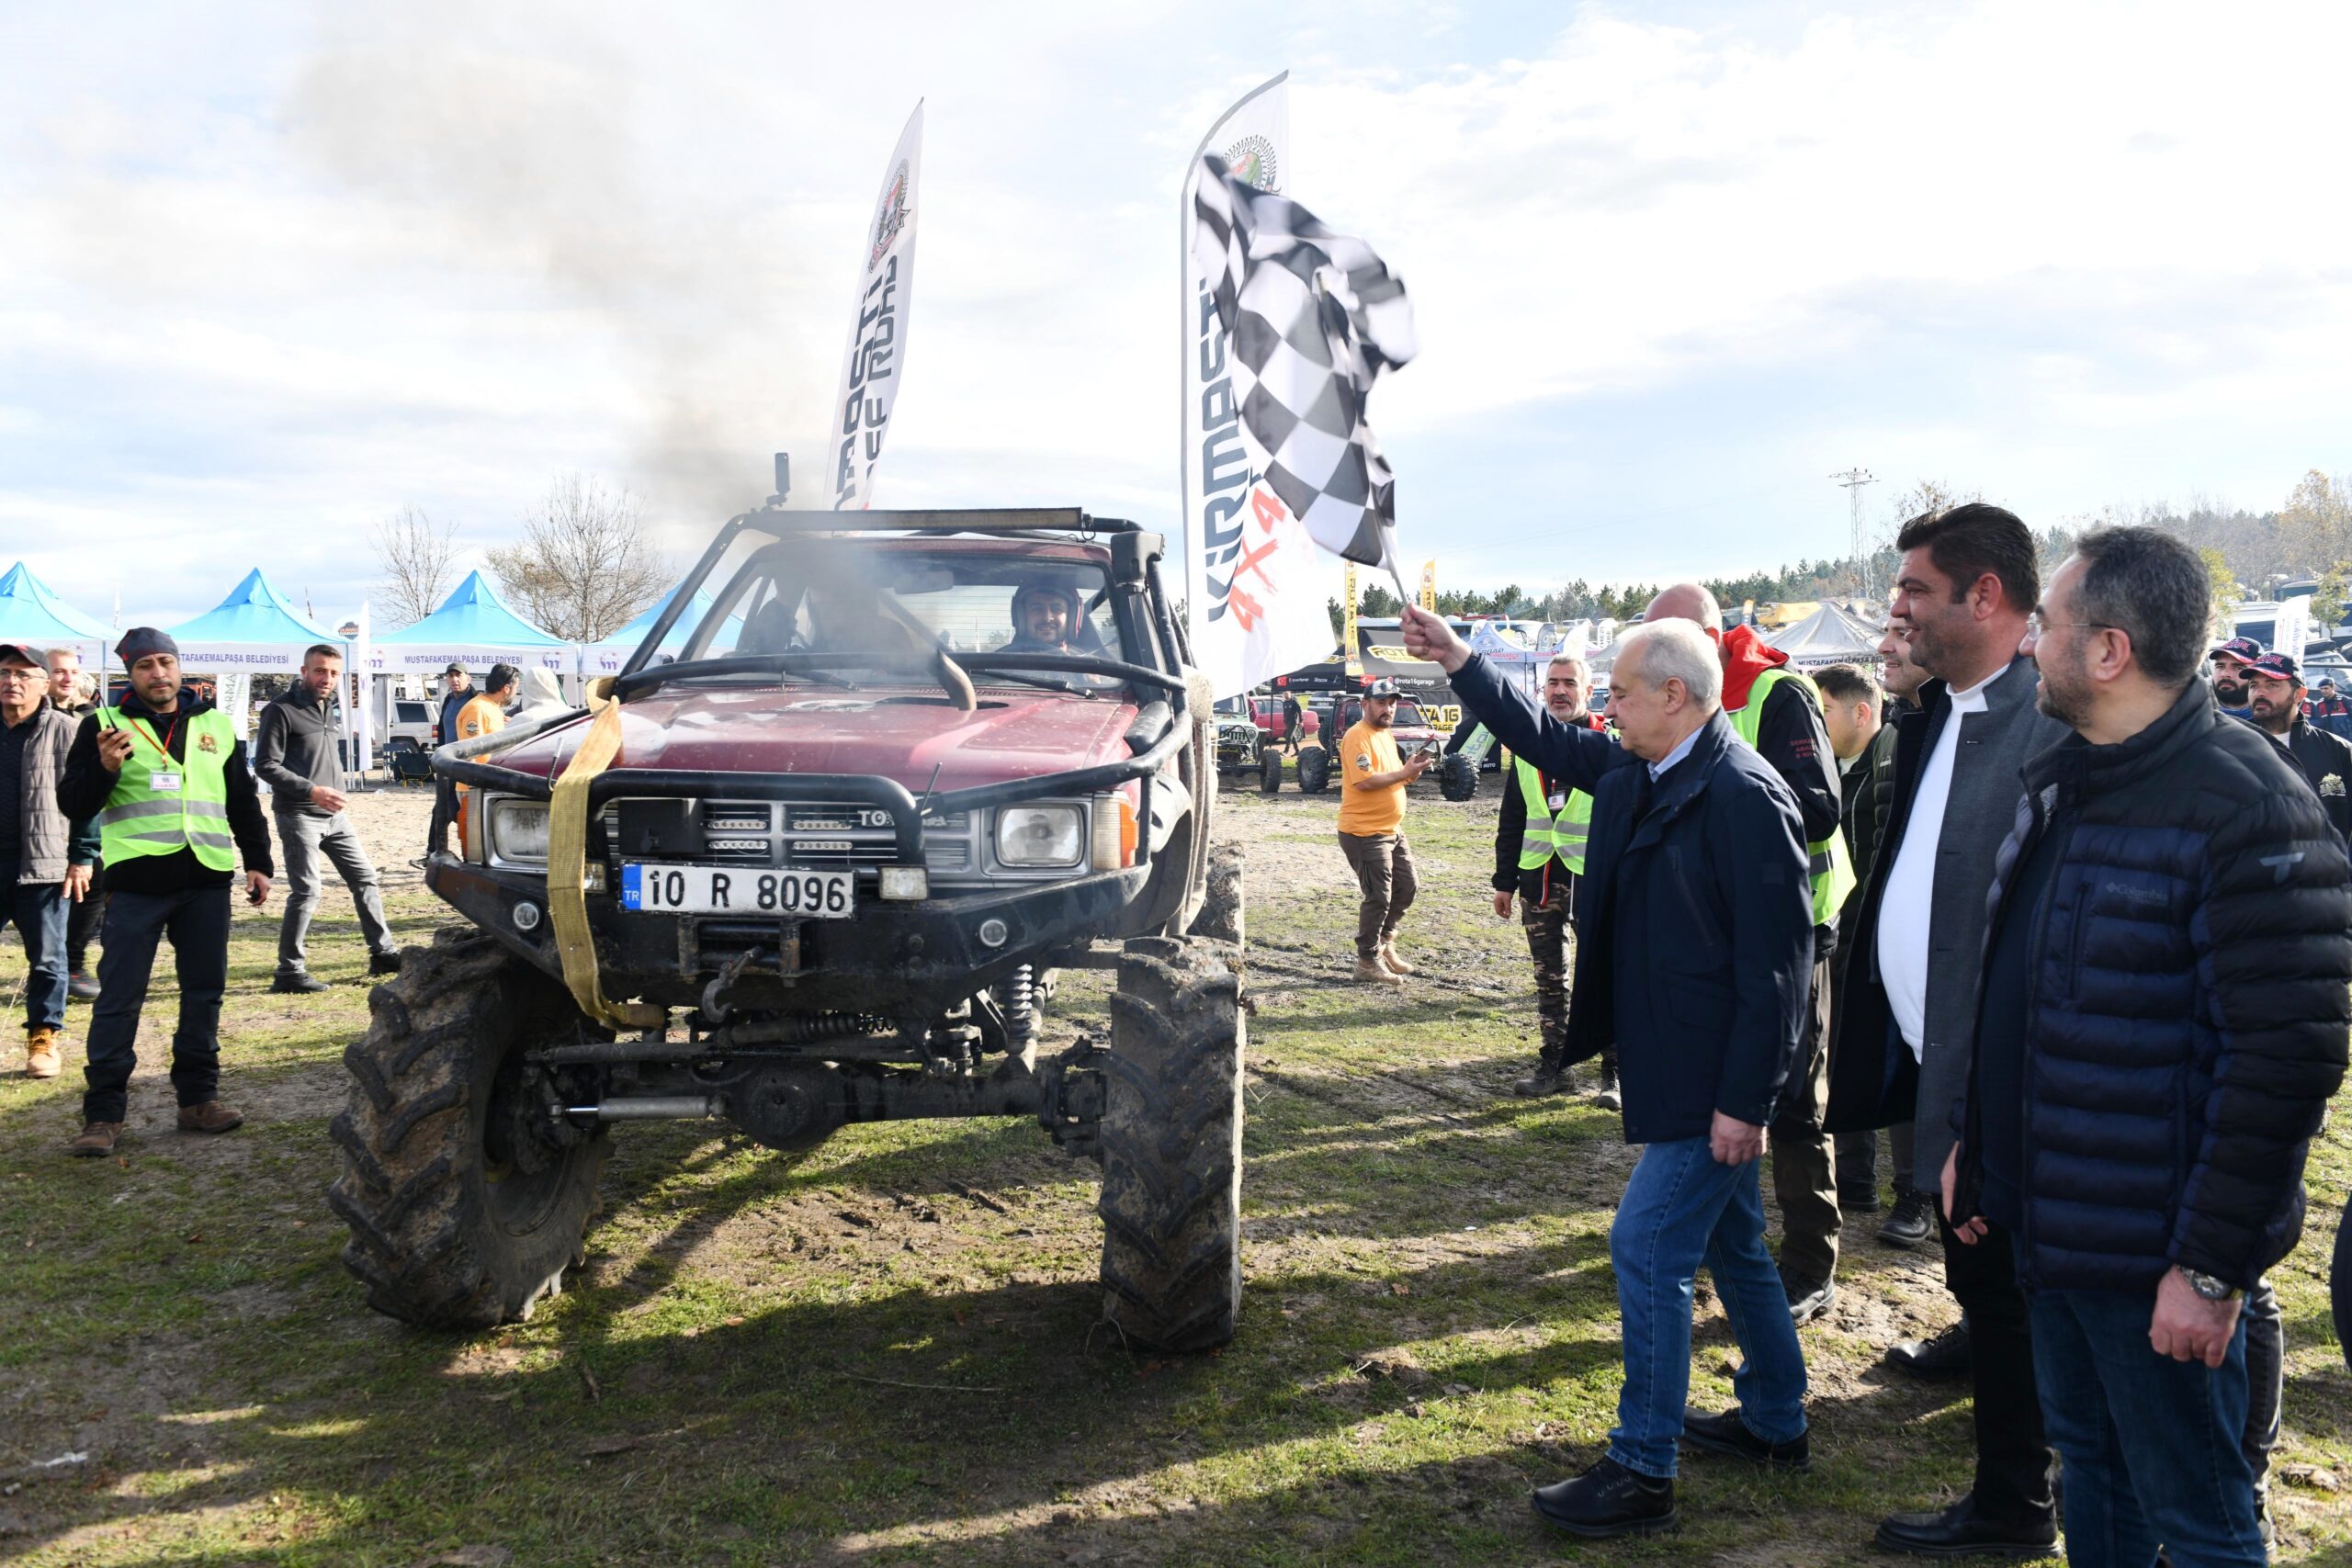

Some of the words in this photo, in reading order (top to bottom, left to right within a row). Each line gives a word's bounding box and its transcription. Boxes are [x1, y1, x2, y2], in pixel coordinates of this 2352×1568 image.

[1372, 647, 1405, 657] ROT
[245, 653, 289, 664] BELEDİYESİ
[404, 654, 481, 666] MUSTAFAKEMALPAŞA
[481, 654, 523, 665] BELEDİYESİ
[1871, 655, 1883, 663] BEL
[1394, 677, 1435, 686] @rota16garage
[1419, 708, 1440, 722] TA
[1443, 708, 1459, 722] 16
[624, 890, 639, 902] TR
[649, 870, 685, 907] 10
[711, 873, 731, 908] R
[757, 874, 846, 912] 8096
[2116, 883, 2168, 901] Columbia
